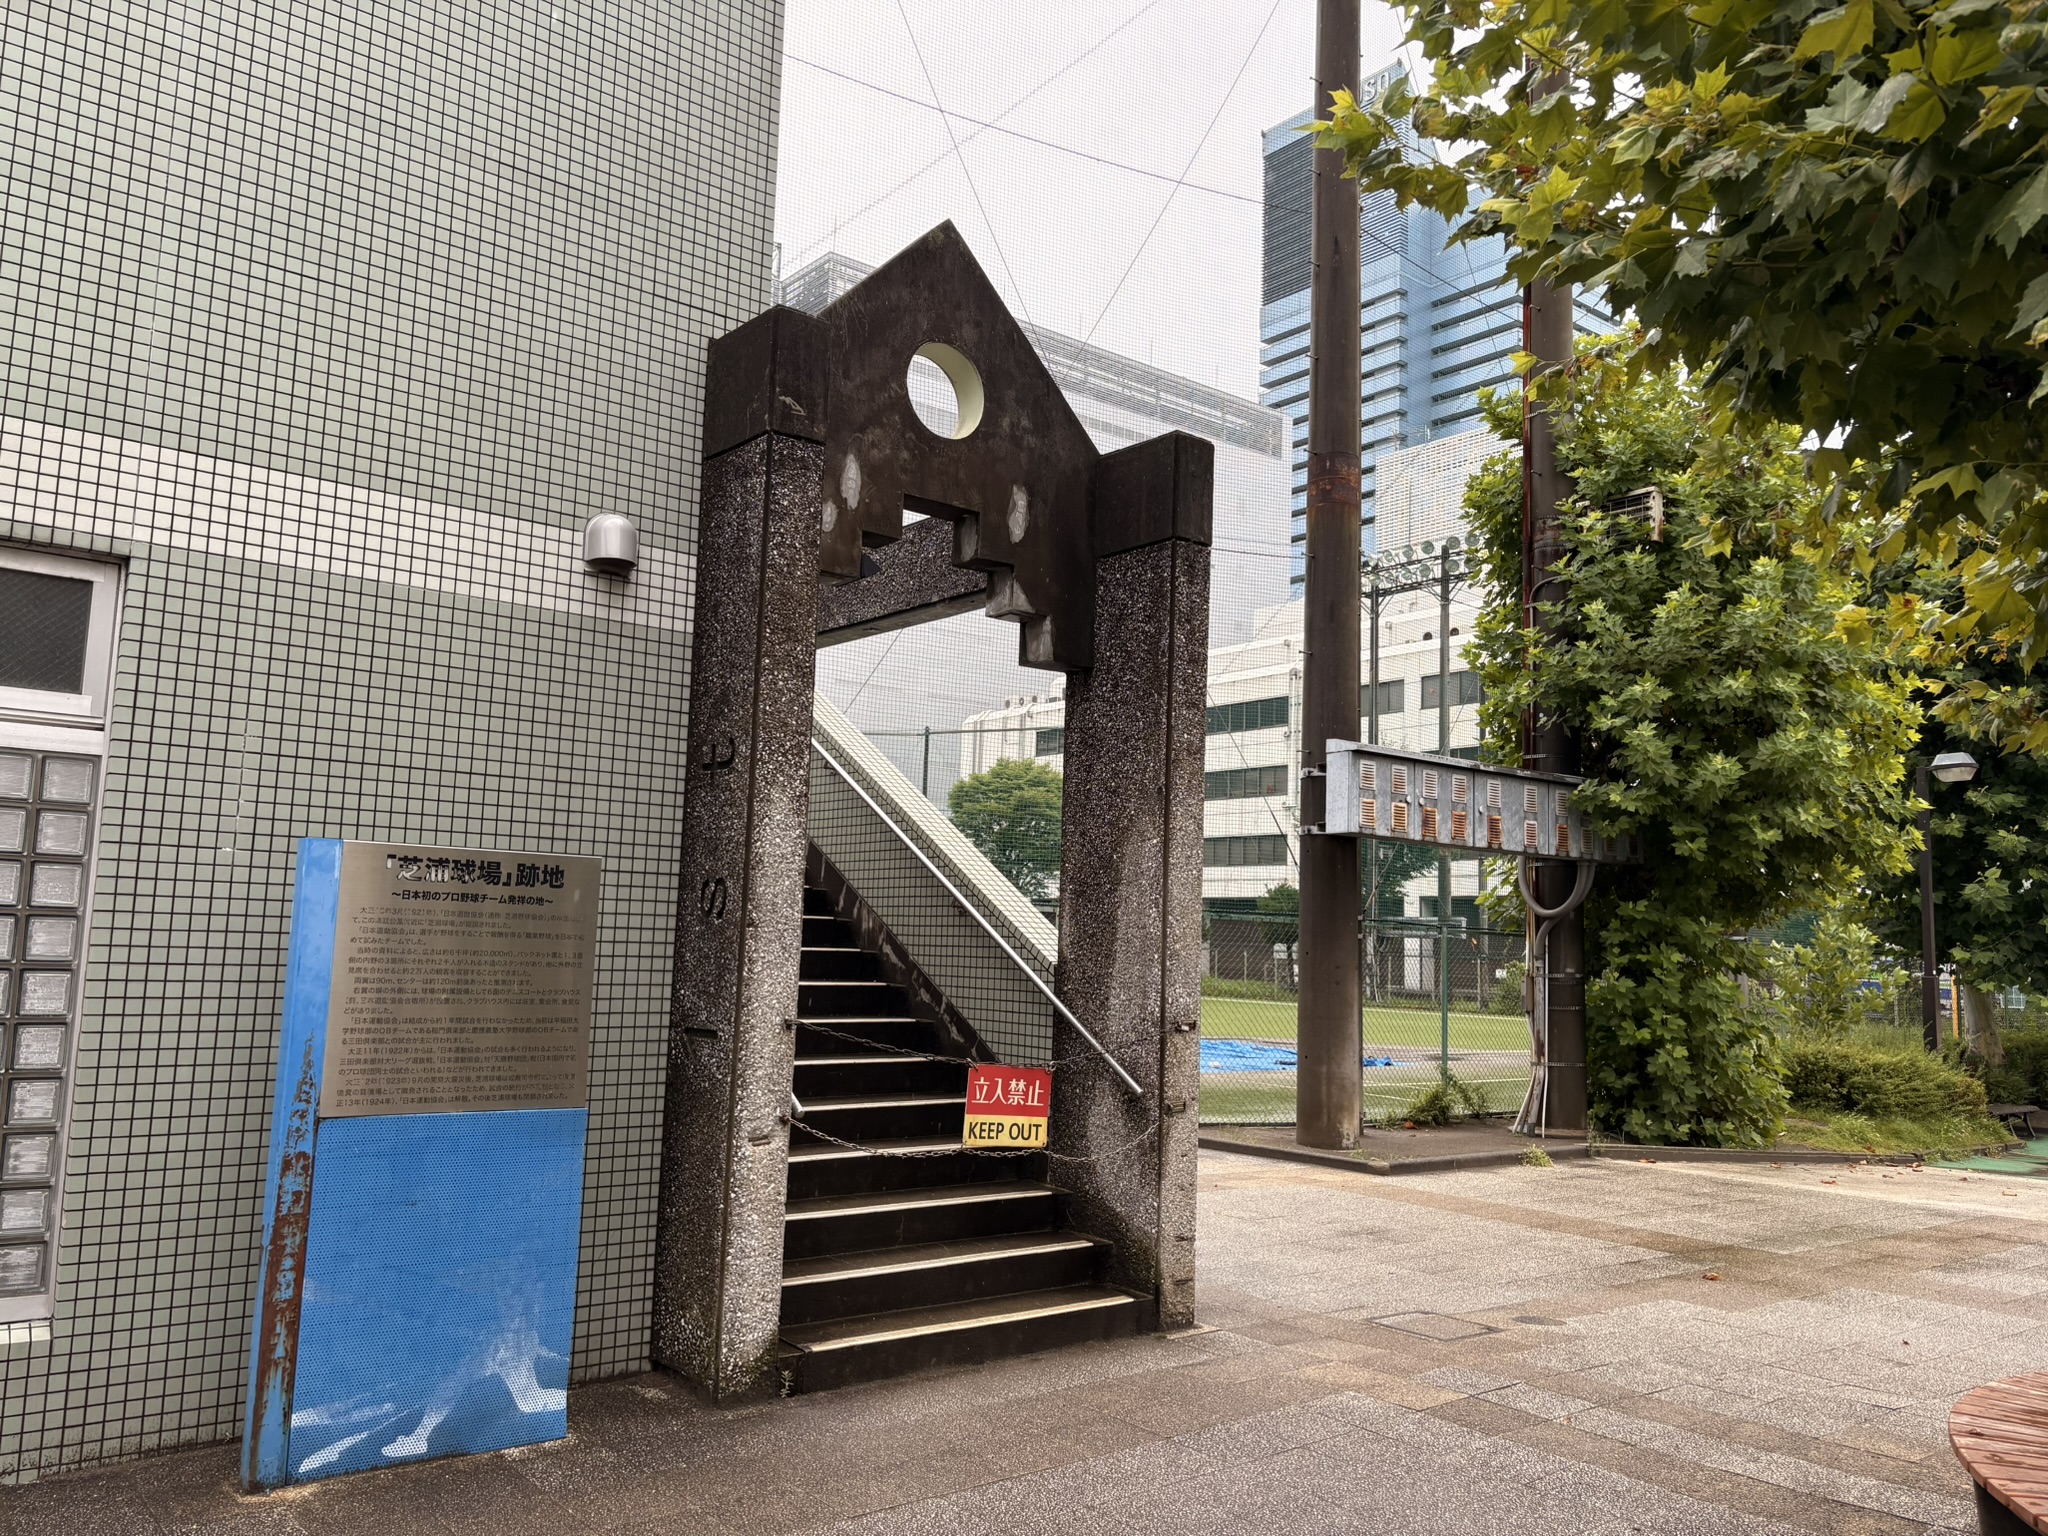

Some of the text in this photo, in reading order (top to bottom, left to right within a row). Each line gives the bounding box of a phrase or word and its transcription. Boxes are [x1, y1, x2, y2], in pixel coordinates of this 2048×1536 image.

[386, 854, 564, 888] 「芝浦球場」跡地
[971, 1076, 1045, 1107] 立入禁止
[968, 1121, 1042, 1141] KEEP OUT
